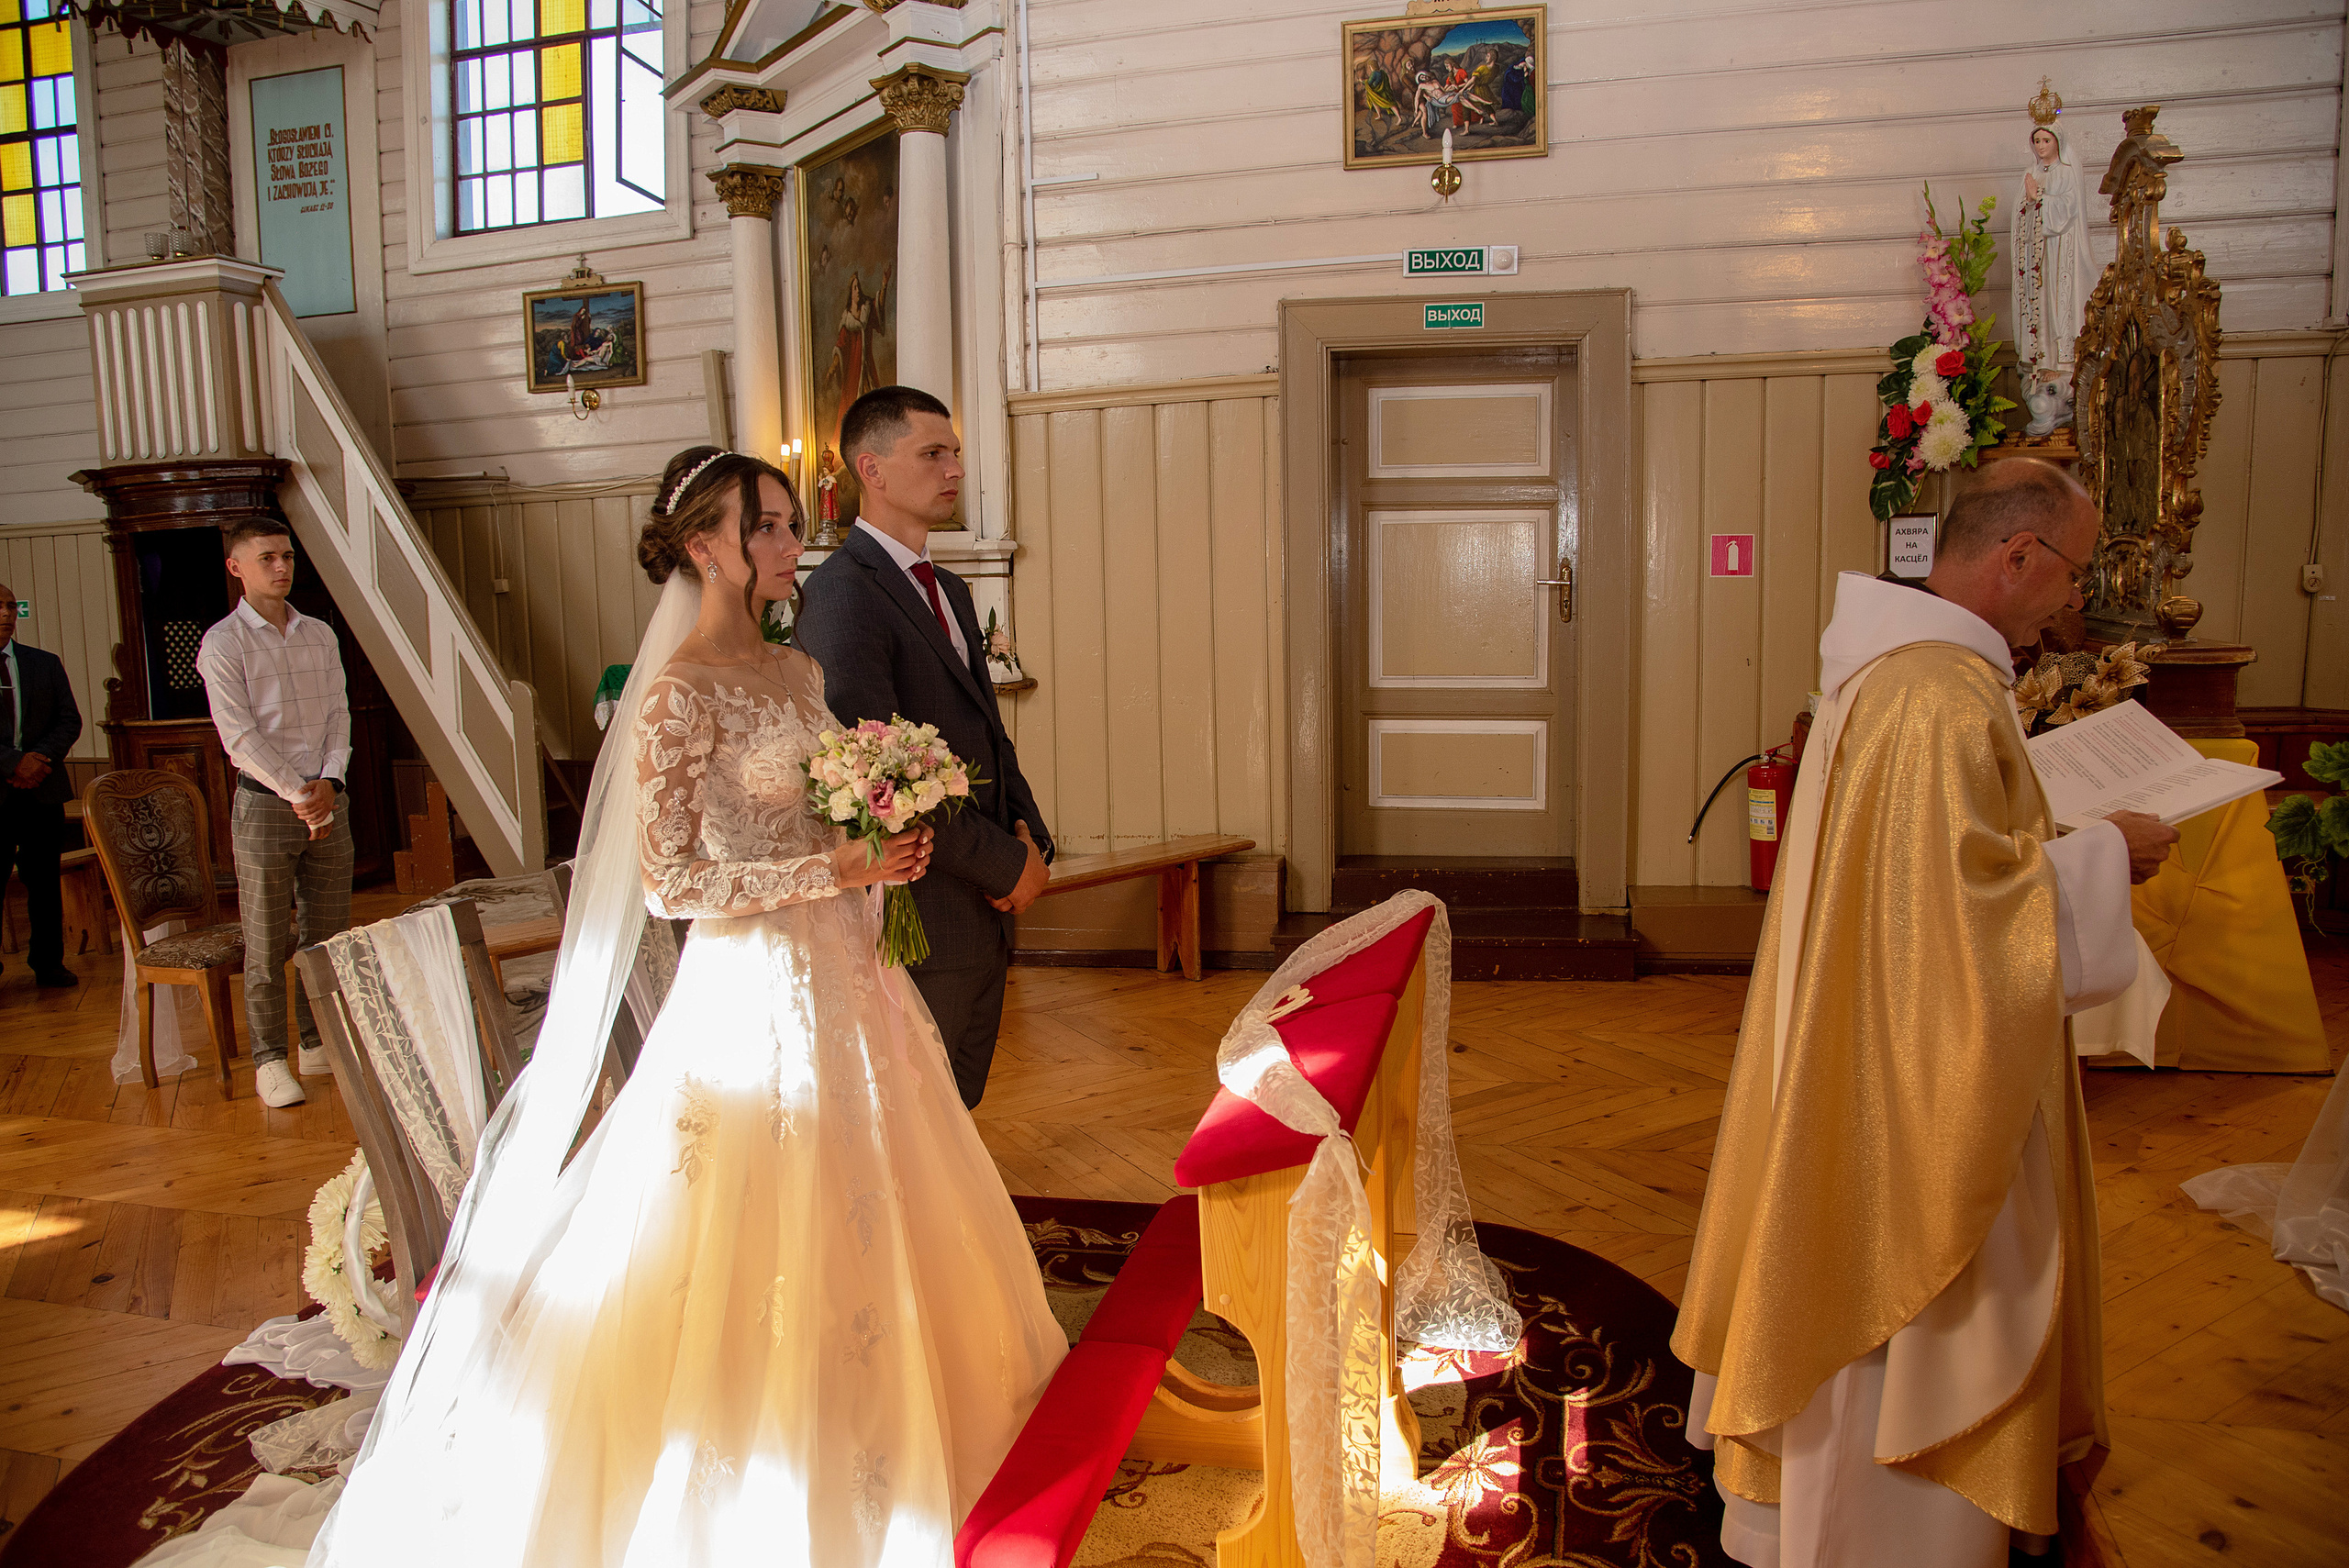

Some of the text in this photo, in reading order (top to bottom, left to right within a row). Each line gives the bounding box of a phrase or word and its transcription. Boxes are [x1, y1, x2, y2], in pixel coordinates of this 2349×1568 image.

[267, 140, 333, 164] KTÓRZY SŁUCHAJĄ
[271, 163, 296, 182] SŁOWA
[268, 186, 271, 201] I
[273, 181, 317, 201] ZACHOWUJĄ
[1411, 251, 1480, 270] ВЫХОД
[1427, 308, 1481, 322] ВЫХОД
[1894, 553, 1928, 563] КАСЦЁЛ
